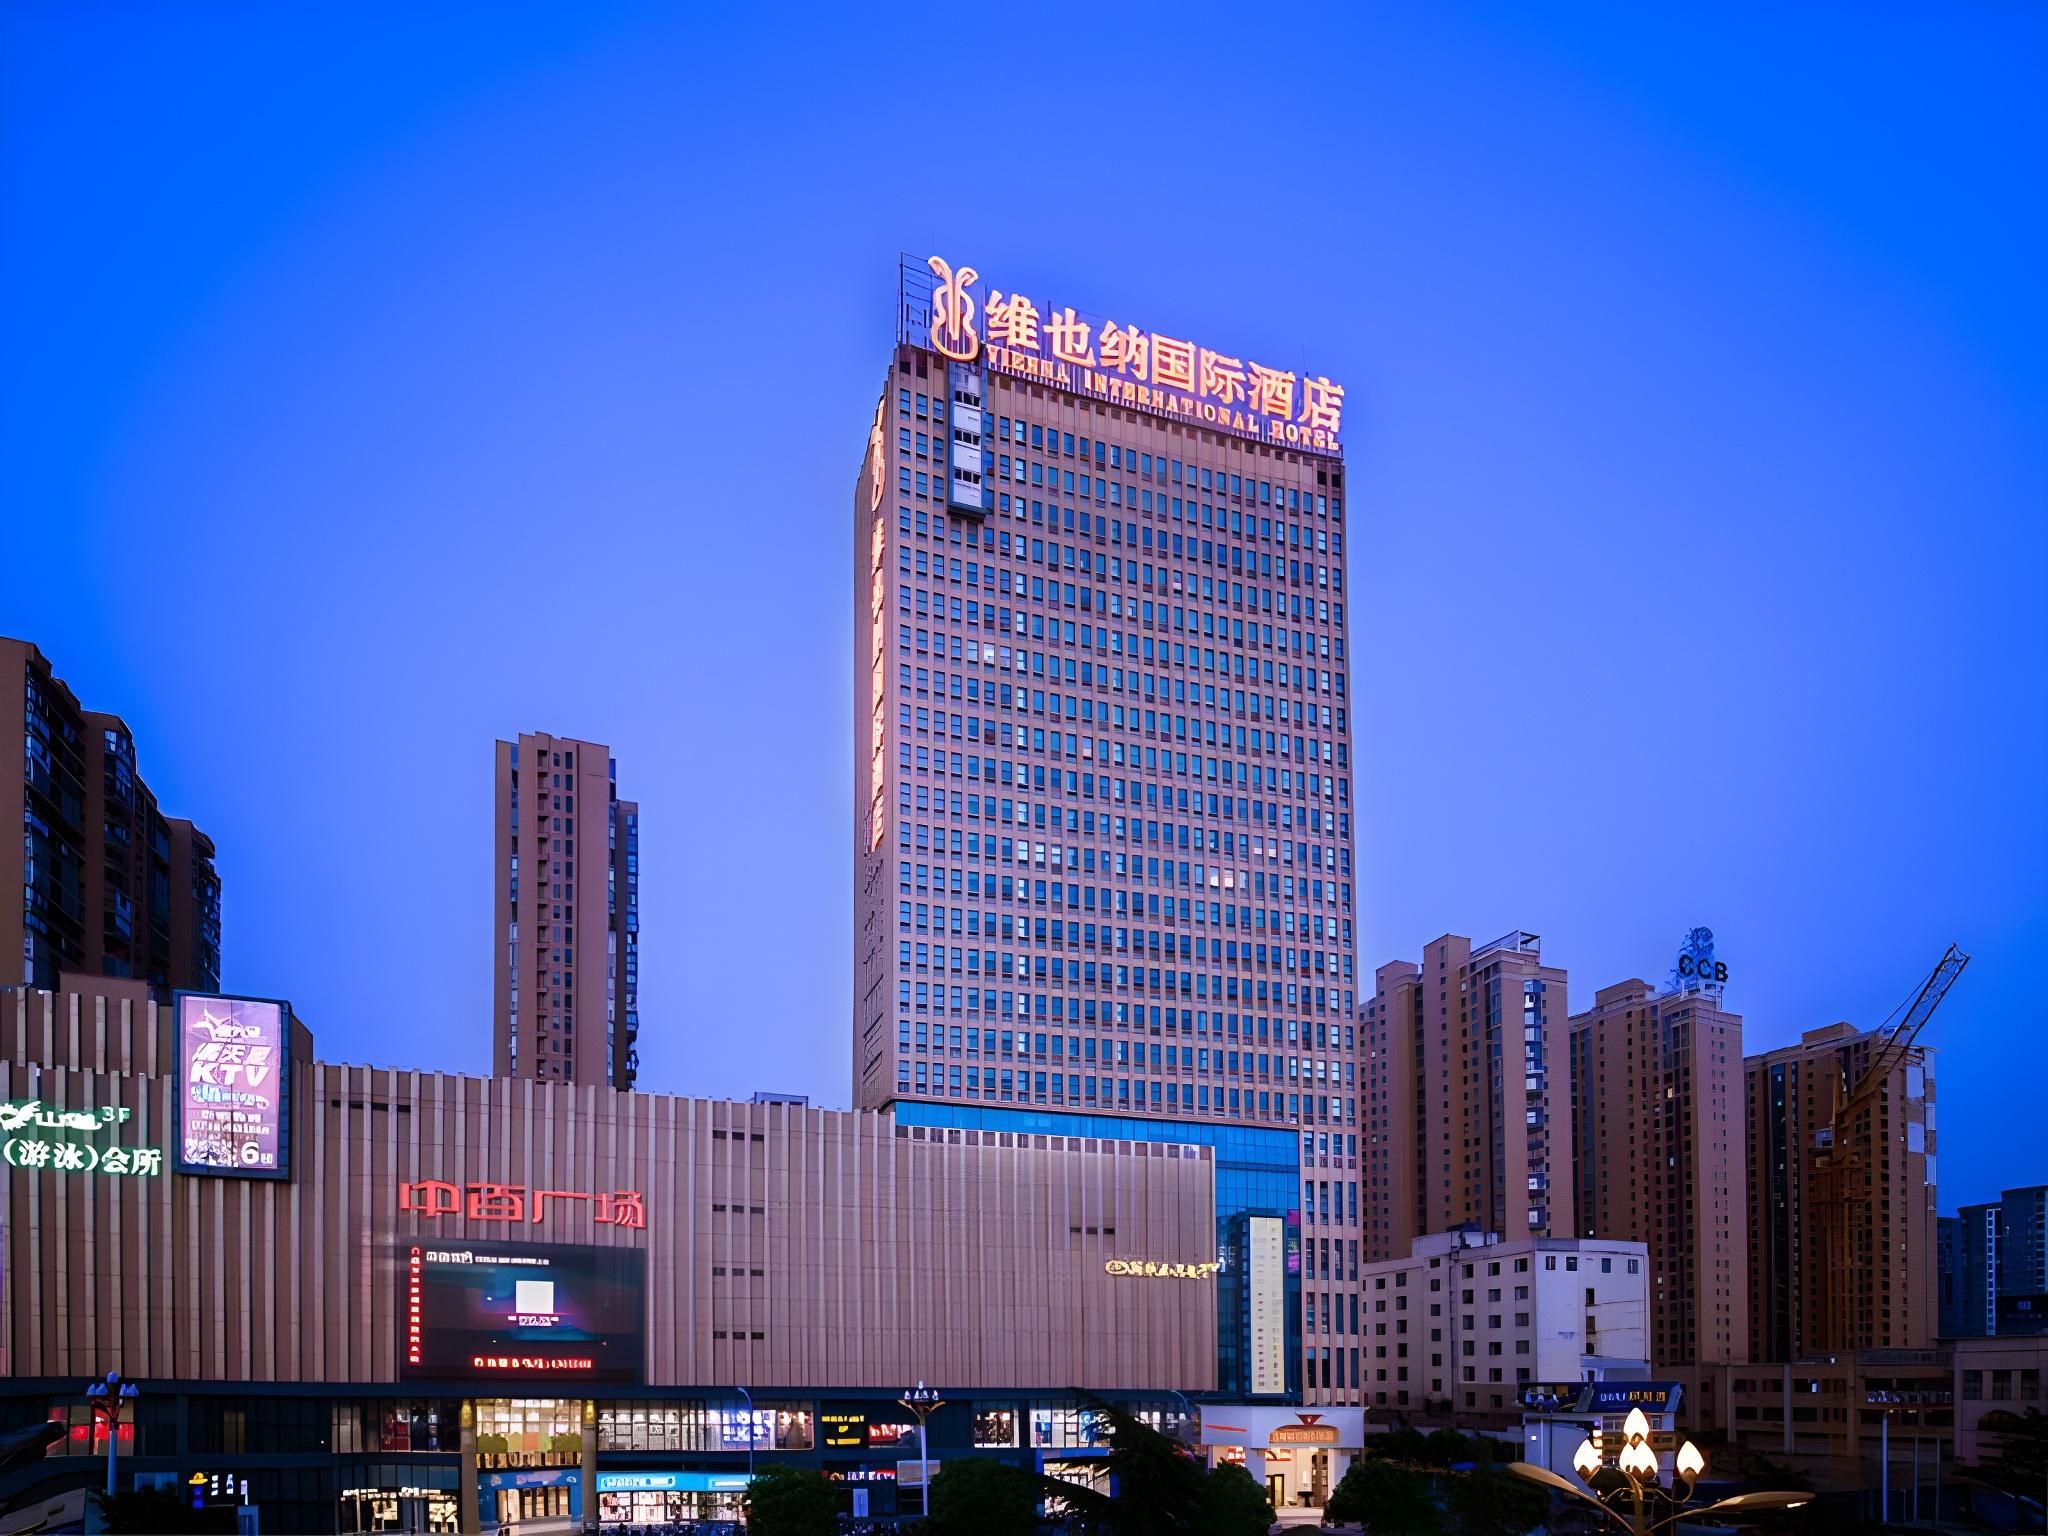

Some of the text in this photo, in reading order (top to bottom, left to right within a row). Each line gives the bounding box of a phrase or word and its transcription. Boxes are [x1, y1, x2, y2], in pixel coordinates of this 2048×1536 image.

[985, 290, 1345, 432] 维也纳国际酒店
[190, 1061, 270, 1087] KTV
